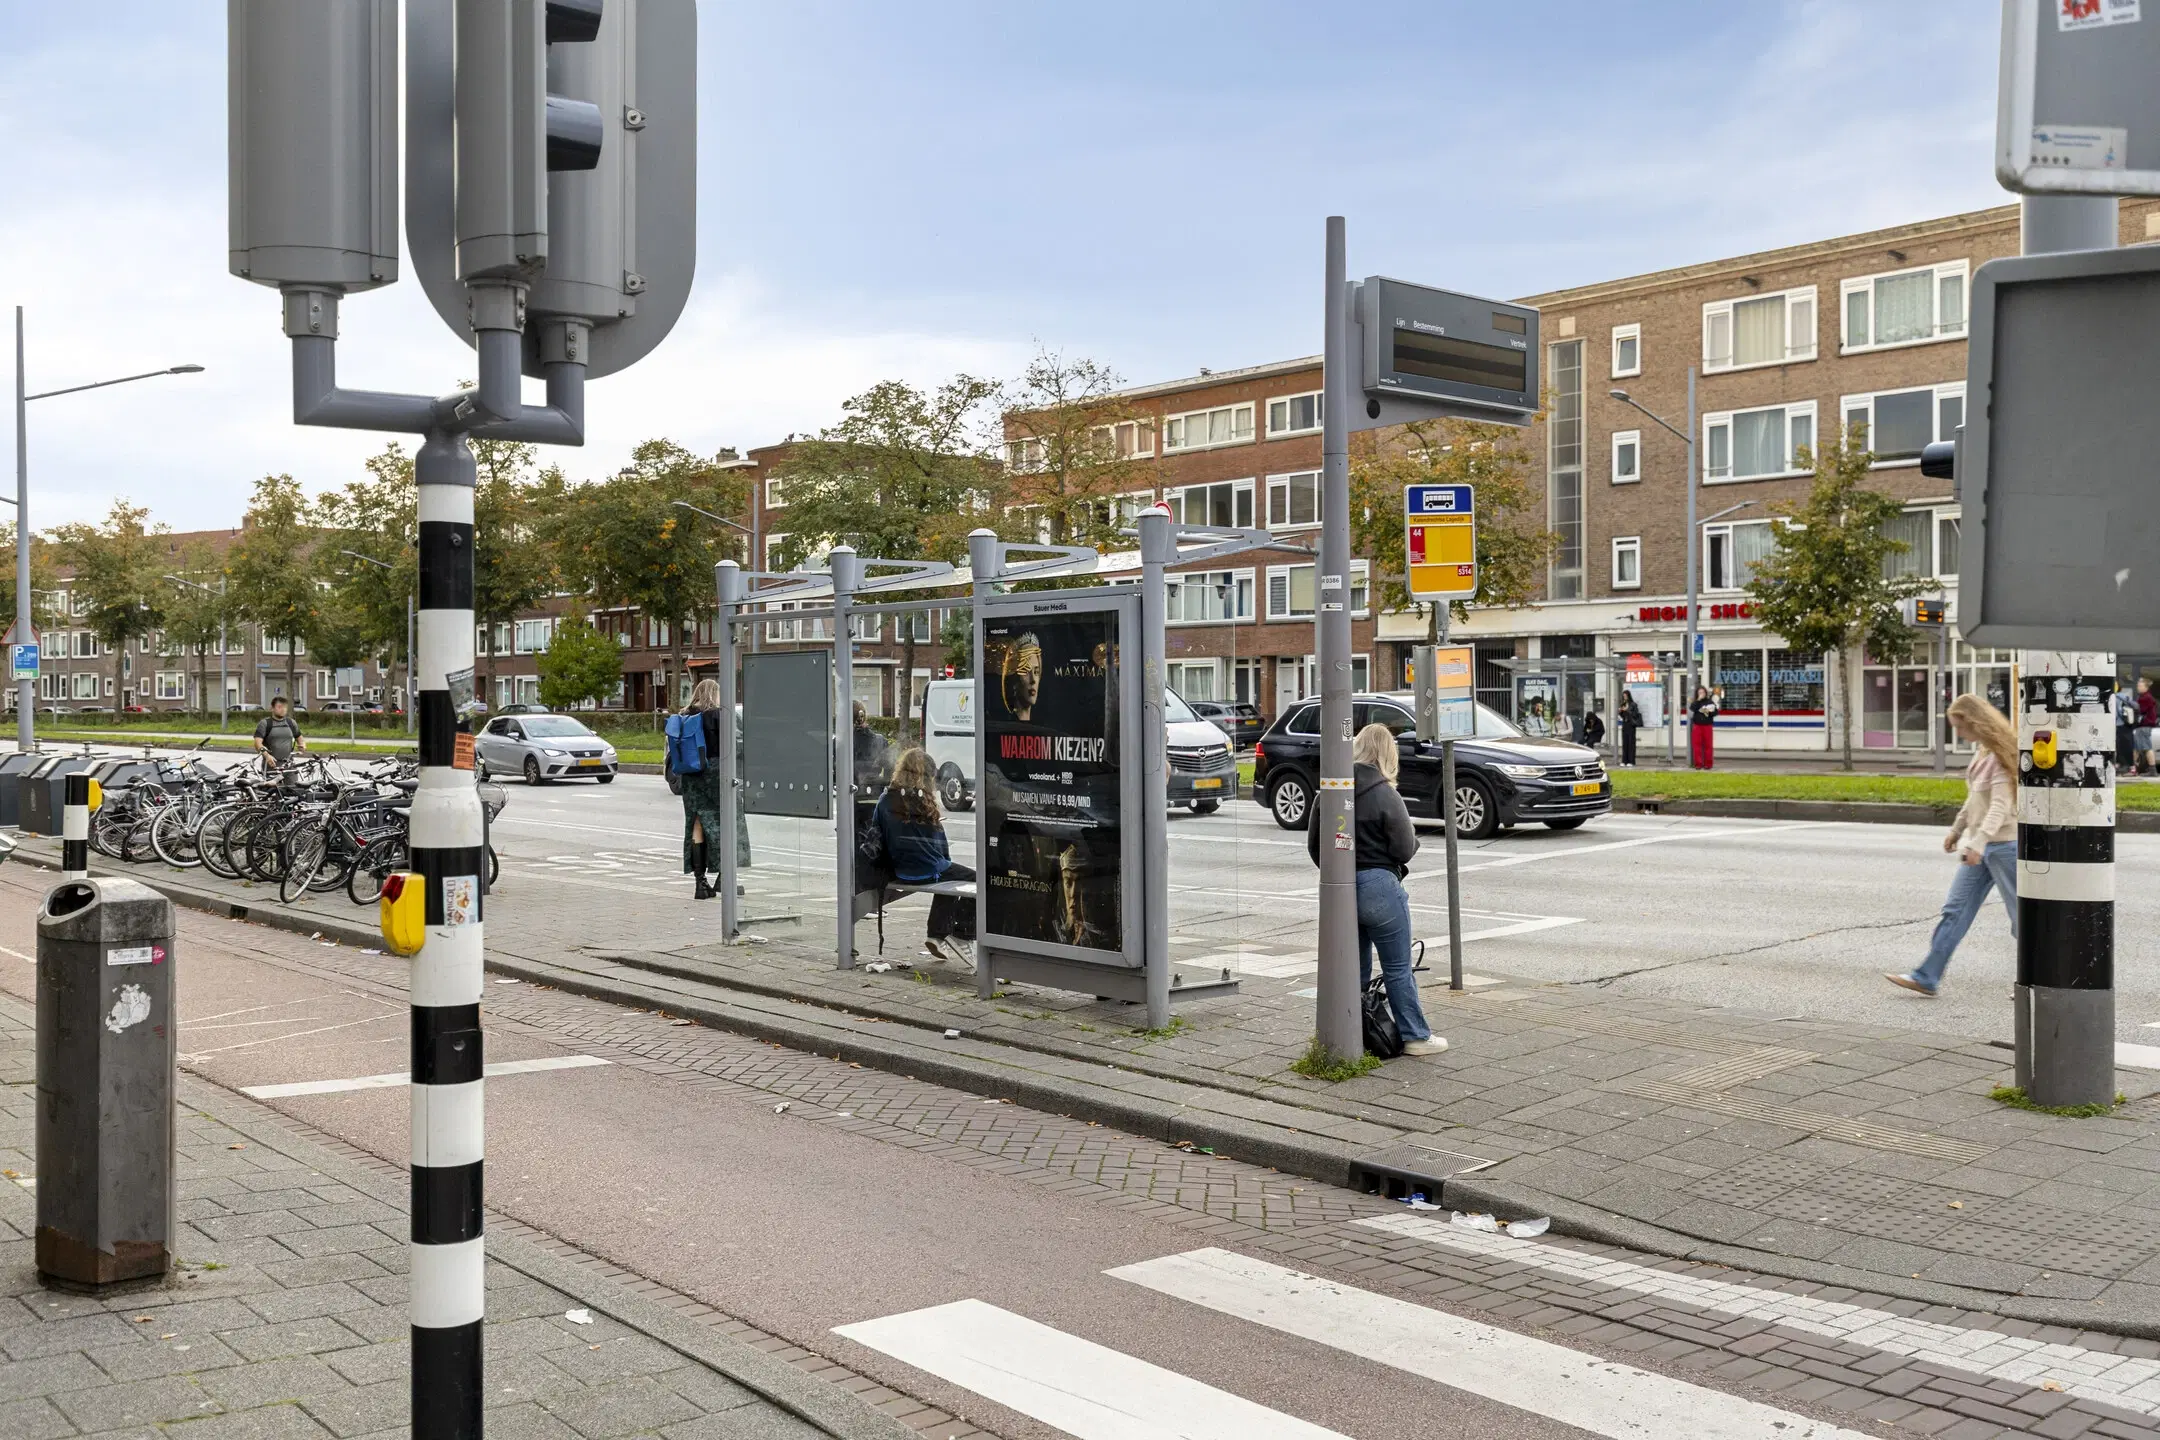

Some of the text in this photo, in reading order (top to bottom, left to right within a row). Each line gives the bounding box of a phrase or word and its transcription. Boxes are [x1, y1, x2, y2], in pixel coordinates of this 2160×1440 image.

[1396, 317, 1444, 335] Lijn Bestemming
[1510, 339, 1526, 349] Vertrek
[1051, 603, 1067, 611] Media
[1639, 602, 1762, 621] NIGH SHO
[15, 646, 24, 657] P
[1714, 669, 1824, 684] AVOND WINKEL
[1001, 735, 1105, 762] WAAROM KIEZEN?
[1013, 791, 1020, 803] NU
[1020, 792, 1039, 805] SAMEN
[1039, 793, 1056, 805] VANAF
